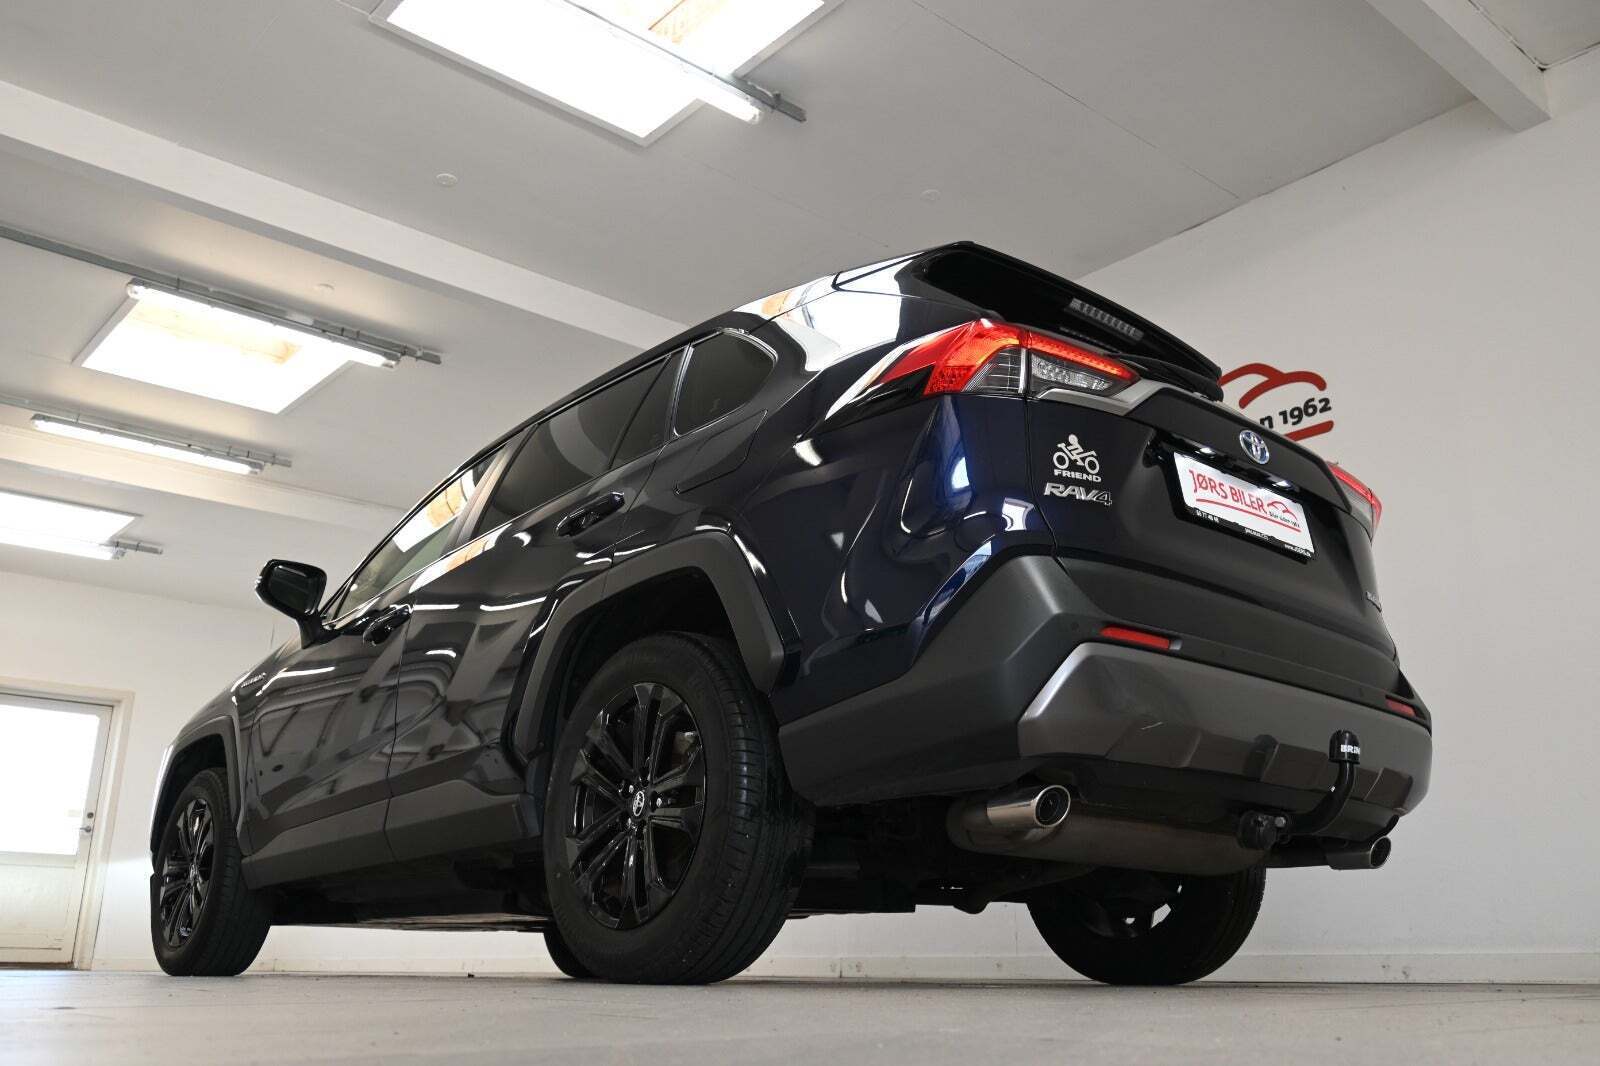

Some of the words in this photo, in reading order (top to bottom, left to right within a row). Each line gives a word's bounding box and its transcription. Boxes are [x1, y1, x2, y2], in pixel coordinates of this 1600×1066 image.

[1279, 397, 1332, 426] 1962
[1053, 469, 1102, 483] FRIEND
[1044, 482, 1112, 506] RAV4
[1188, 469, 1228, 499] JØRS
[1229, 485, 1268, 514] BILER
